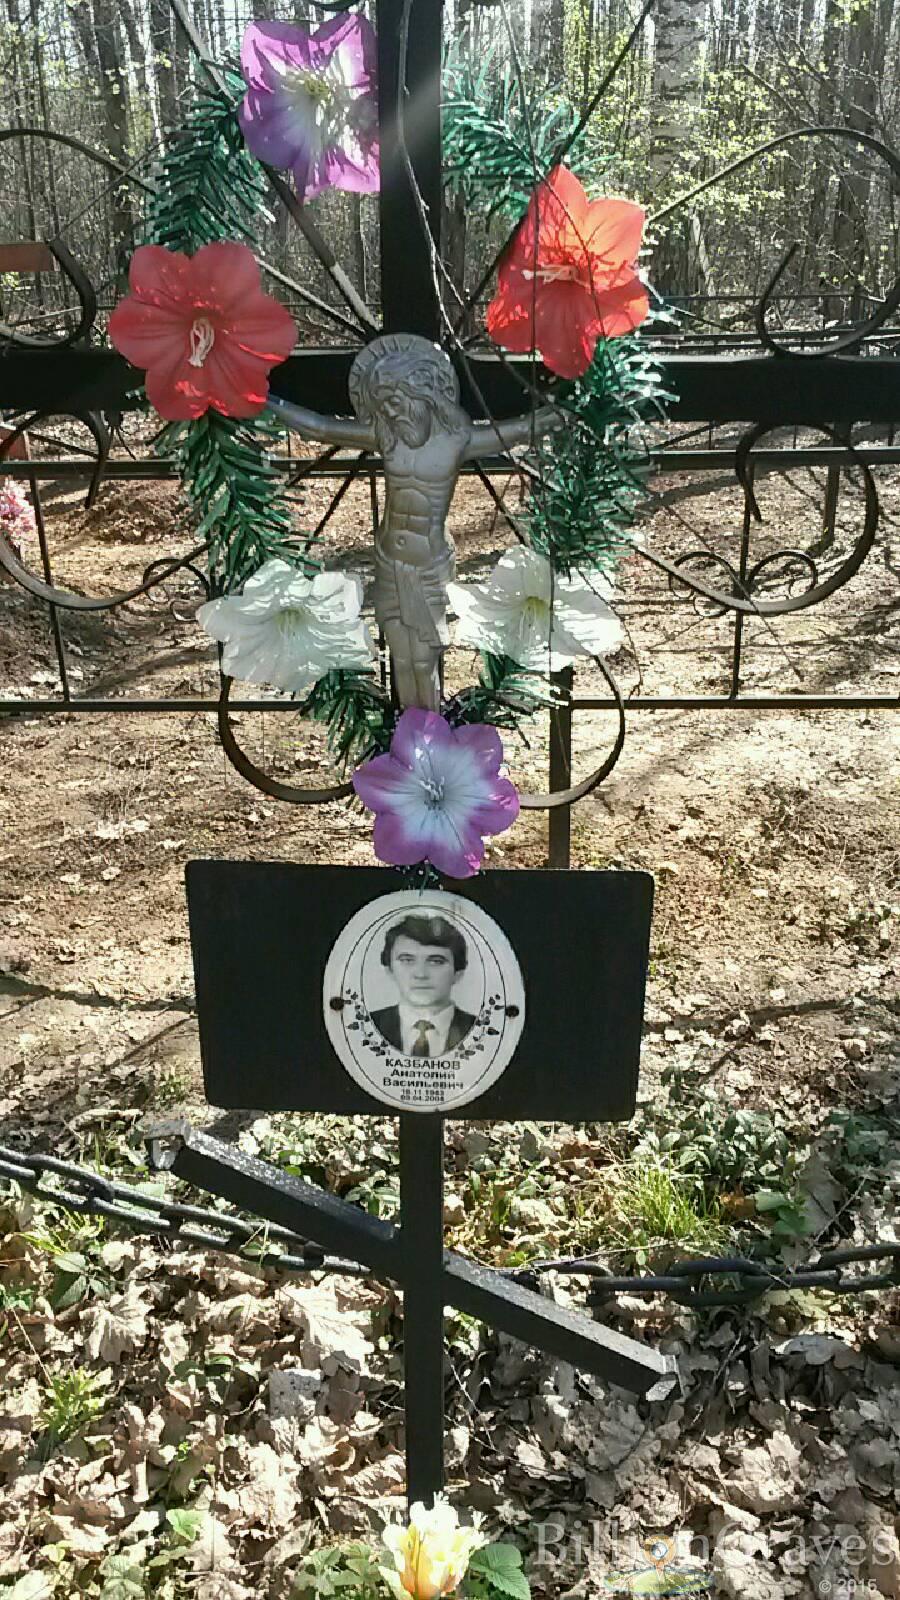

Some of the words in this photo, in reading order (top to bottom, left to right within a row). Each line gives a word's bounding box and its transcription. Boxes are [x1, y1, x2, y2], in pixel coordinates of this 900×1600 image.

[385, 1058, 461, 1070] КАЗБАНОВ
[391, 1068, 456, 1080] Анатолий
[383, 1077, 464, 1090] Васильевич
